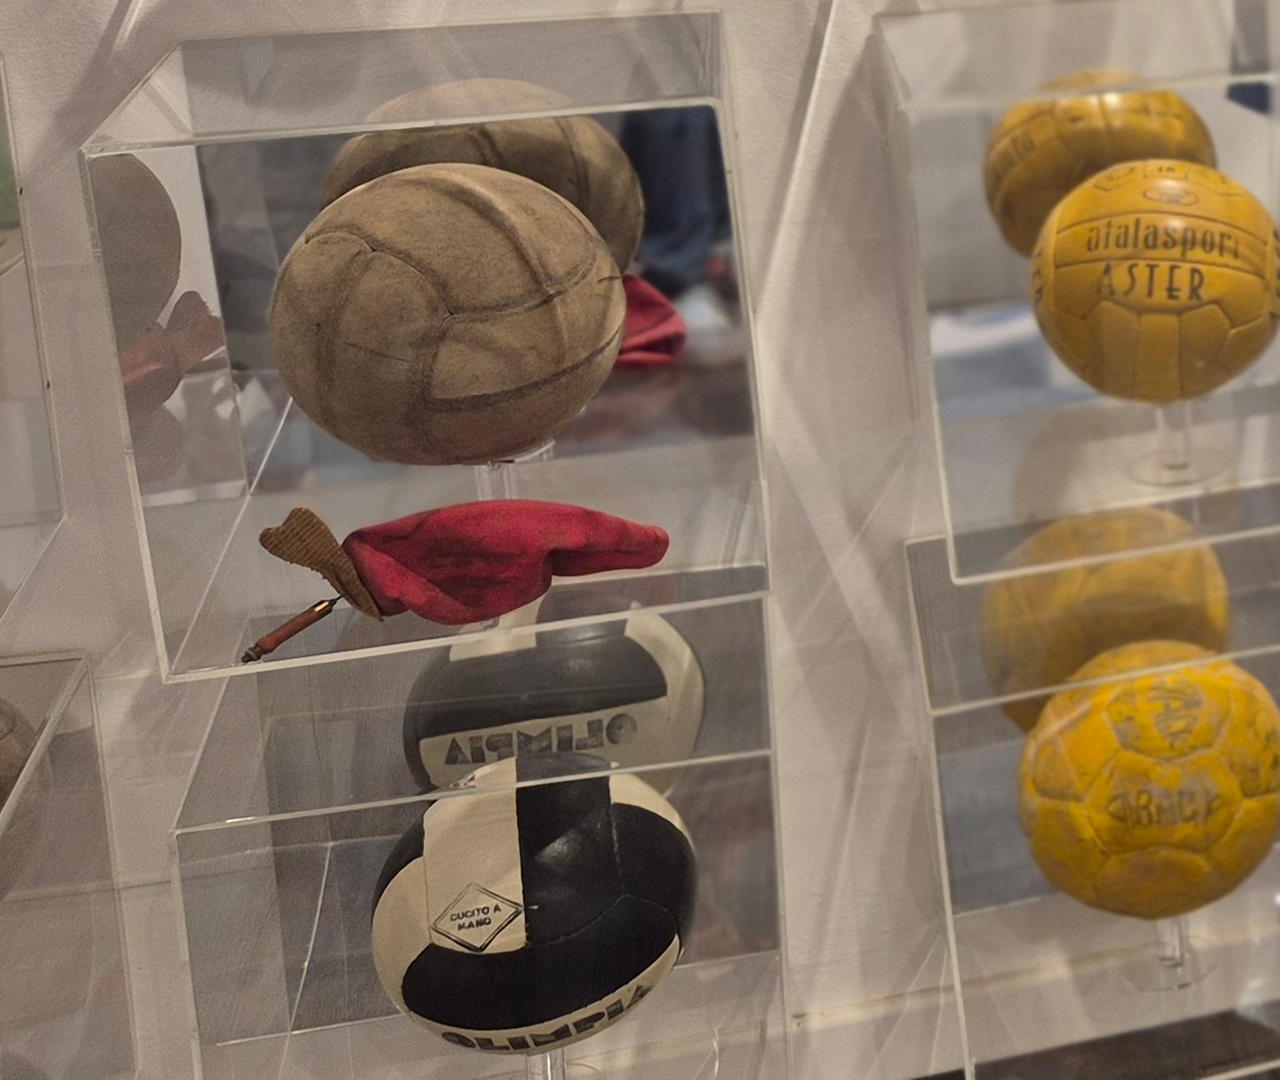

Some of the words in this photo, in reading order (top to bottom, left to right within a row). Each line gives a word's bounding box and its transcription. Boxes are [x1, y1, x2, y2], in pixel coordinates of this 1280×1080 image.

[1099, 263, 1205, 302] ASTER
[450, 906, 490, 921] CUCITO
[493, 904, 502, 913] A
[457, 917, 492, 931] MANO
[441, 985, 653, 1051] OLIMPIA
